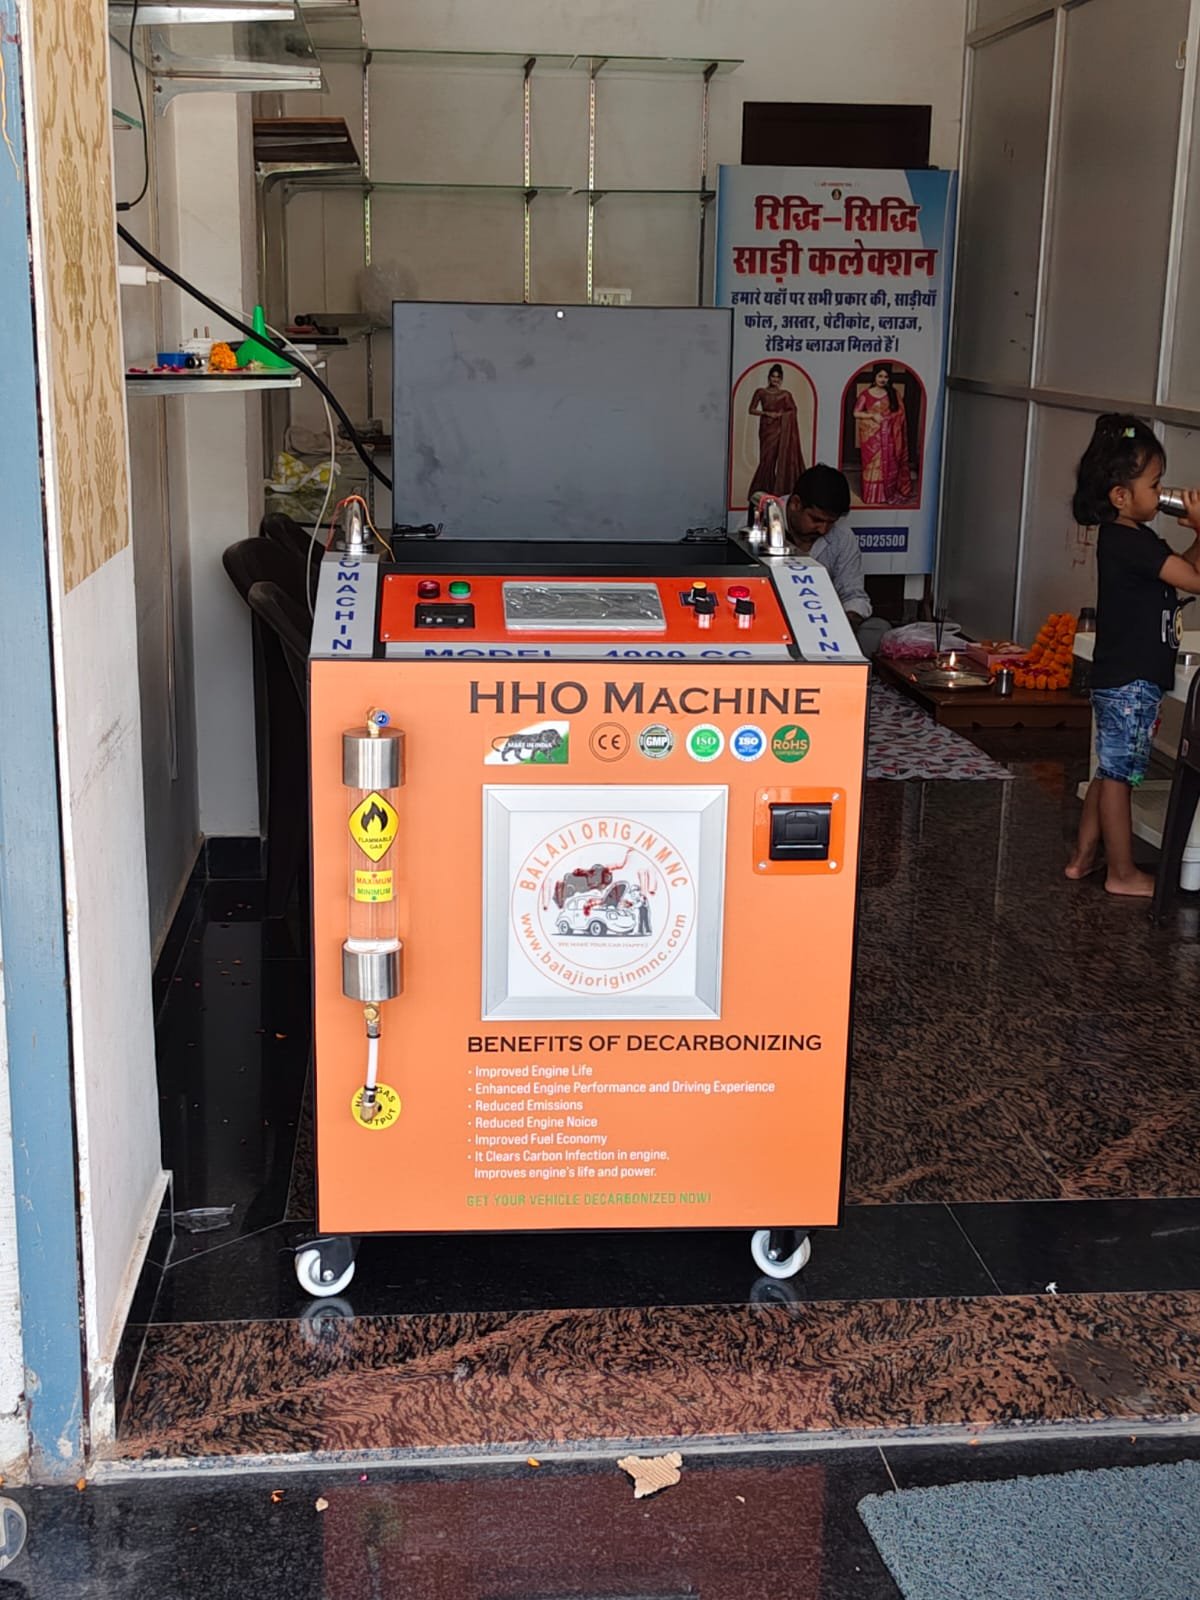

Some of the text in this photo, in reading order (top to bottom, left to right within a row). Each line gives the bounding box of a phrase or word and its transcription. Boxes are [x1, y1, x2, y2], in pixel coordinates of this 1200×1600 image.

[733, 239, 938, 283] साड़ी कलेक्शन
[731, 288, 761, 305] हमारे
[789, 291, 805, 305] पर
[808, 288, 833, 305] सभी
[835, 292, 868, 306] प्रकार
[744, 311, 922, 332] फोल, अस्तर, पेटीकोट, ब्लाउज,
[765, 335, 803, 352] रेडिमेड
[806, 338, 845, 353] ब्लाउज
[848, 335, 882, 353] मिलते
[470, 680, 821, 716] HHO MACHINE
[598, 734, 621, 750] CE
[646, 735, 668, 746] GMP
[696, 736, 716, 746] ISO
[738, 736, 759, 746] ISO
[773, 739, 808, 750] RoHS
[519, 829, 577, 892] BALAJI
[356, 877, 392, 885] MAXIMUM
[357, 887, 391, 895] MINIMUM
[520, 913, 687, 989] www.balajioriginmnc.com
[468, 1034, 822, 1053] BENEFITS OF DECARBONIZING
[475, 1064, 593, 1079] Improved Engine Life
[377, 1087, 396, 1103] GAS
[475, 1080, 775, 1096] Enhanced Engine Performance and Driving Experience
[475, 1099, 583, 1112] Reduced Emissions
[475, 1115, 598, 1130] Reduced Engine Noice
[475, 1132, 608, 1147] Improved Fuel Economy
[475, 1151, 483, 1162] It
[485, 1150, 521, 1162] Clears
[523, 1149, 563, 1162] Carbon
[565, 1149, 615, 1161] Infection
[617, 1149, 628, 1161] in
[474, 1166, 657, 1180] Improves engine's life and power.
[466, 1195, 488, 1207] GET
[495, 1194, 526, 1207] YOUR
[530, 1193, 580, 1206] VEHICLE
[584, 1192, 676, 1205] DECARBONIZED
